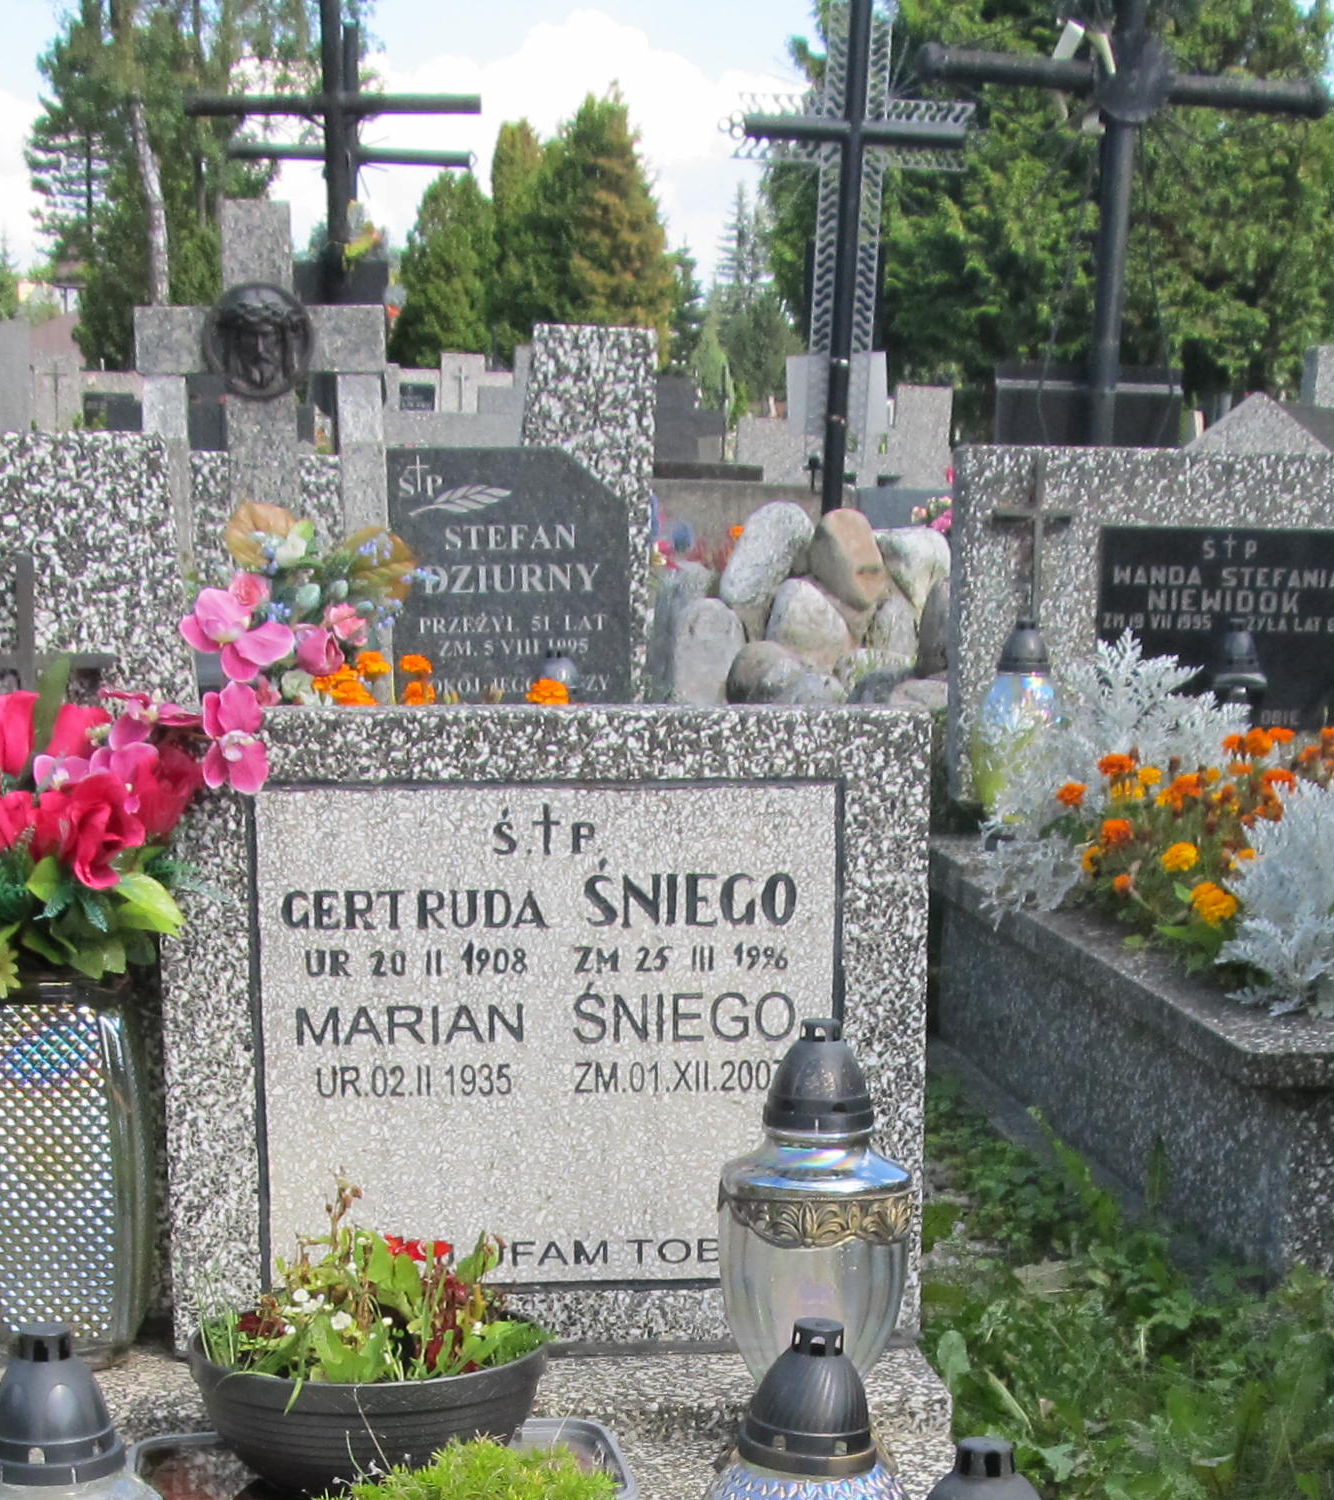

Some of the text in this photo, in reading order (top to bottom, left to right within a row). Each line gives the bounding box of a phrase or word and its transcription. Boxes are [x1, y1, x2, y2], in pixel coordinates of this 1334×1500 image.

[445, 523, 577, 551] STEFAN
[421, 562, 601, 595] DZIURNY
[1113, 565, 1202, 587] WANDA
[1147, 587, 1300, 615] NIEWIDOK
[564, 614, 607, 632] LAT
[280, 858, 798, 930] GERTRUDA ŚNIEGO
[304, 948, 352, 978] UR
[370, 949, 407, 977] 20
[460, 941, 529, 976] 1908
[573, 946, 620, 975] ZM
[634, 946, 674, 973] 25
[691, 944, 715, 973] III
[733, 941, 789, 970] 1996
[295, 982, 797, 1046] MARIAN ŚNIEGO
[444, 1063, 512, 1097] 1935
[625, 1237, 719, 1265] TOB
